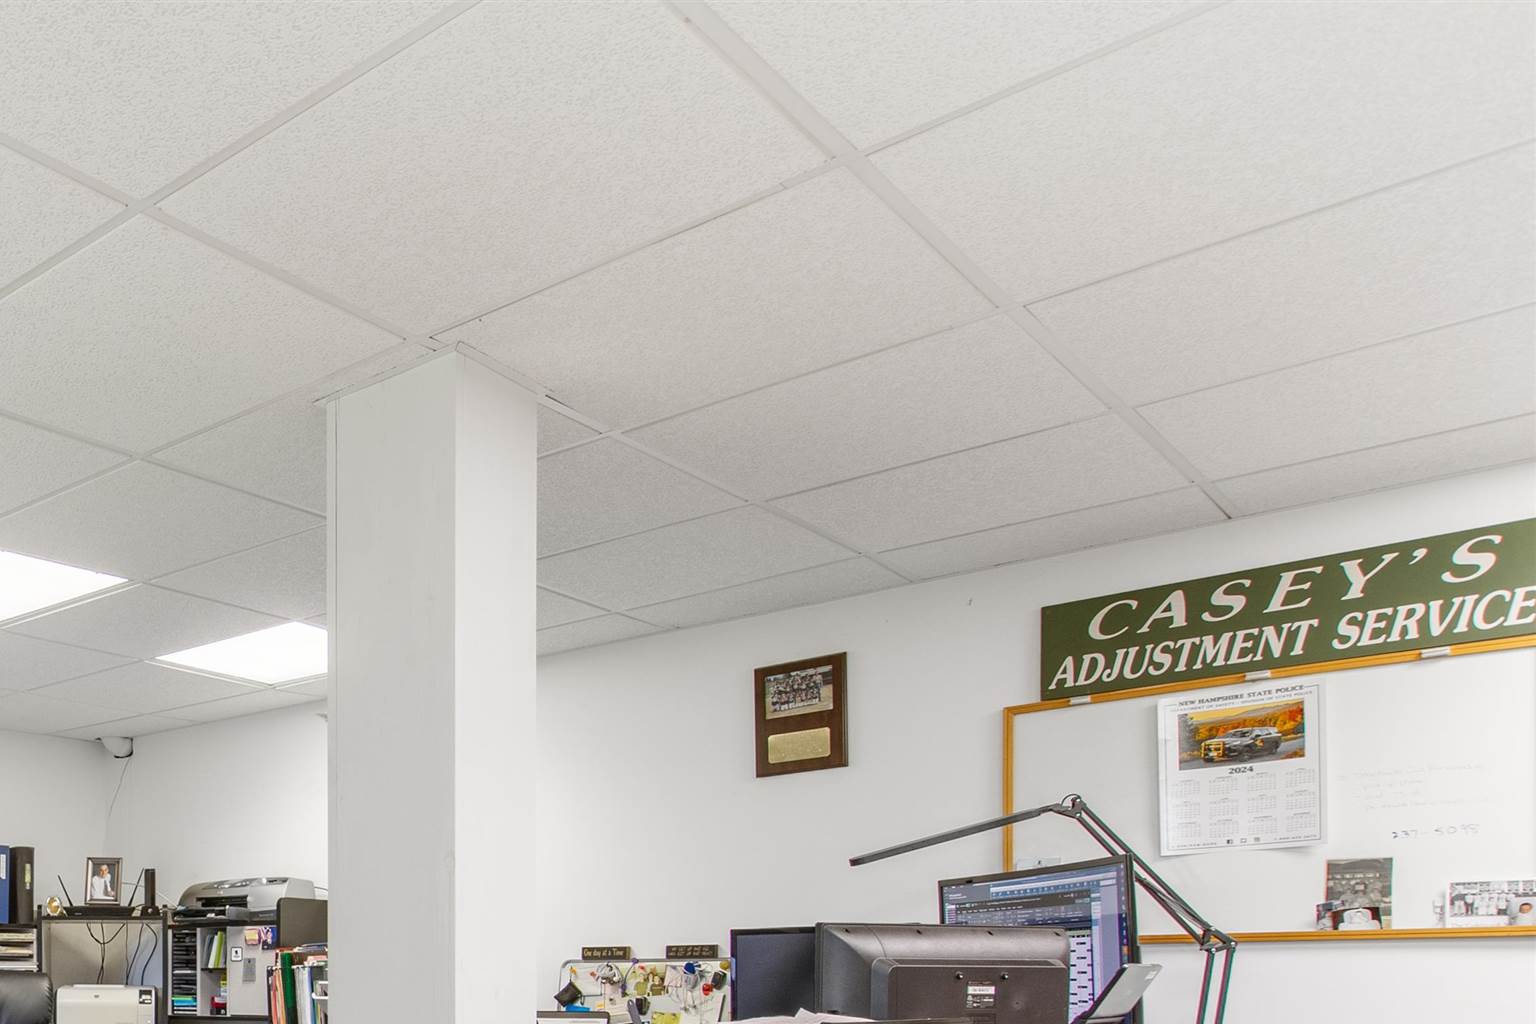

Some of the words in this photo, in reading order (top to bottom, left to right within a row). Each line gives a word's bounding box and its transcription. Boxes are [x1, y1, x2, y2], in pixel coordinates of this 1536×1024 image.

[1087, 534, 1503, 641] CASEY'S
[1047, 617, 1321, 691] ADJUSTMENT
[1331, 585, 1536, 651] SERVICE
[1178, 699, 1196, 707] NEW
[1198, 693, 1244, 704] HAMPSHIRE
[1247, 689, 1274, 698] STATE
[1275, 684, 1305, 693] POLICE
[1228, 766, 1254, 775] 2024
